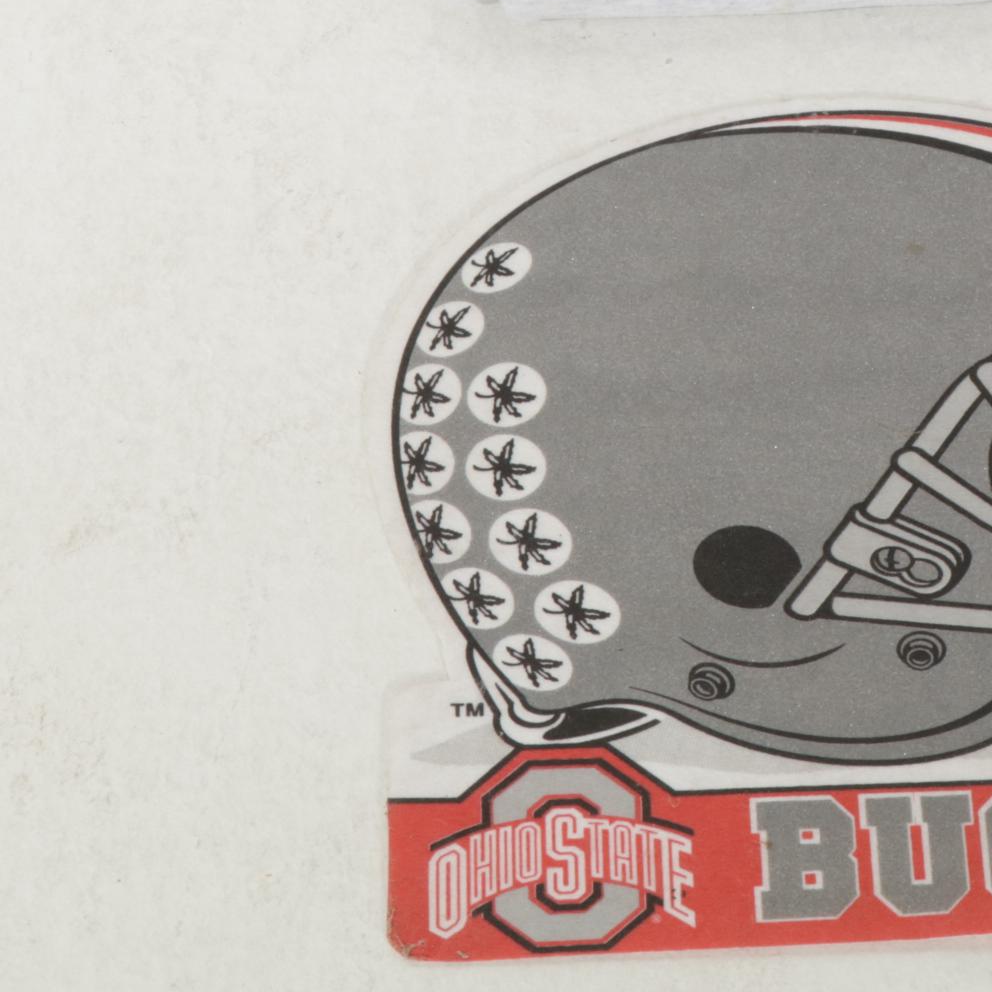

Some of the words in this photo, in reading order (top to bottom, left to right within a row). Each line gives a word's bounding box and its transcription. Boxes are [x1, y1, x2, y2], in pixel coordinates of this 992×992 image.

[450, 703, 485, 718] TM
[428, 820, 543, 939] OHIO
[545, 807, 697, 928] STATE
